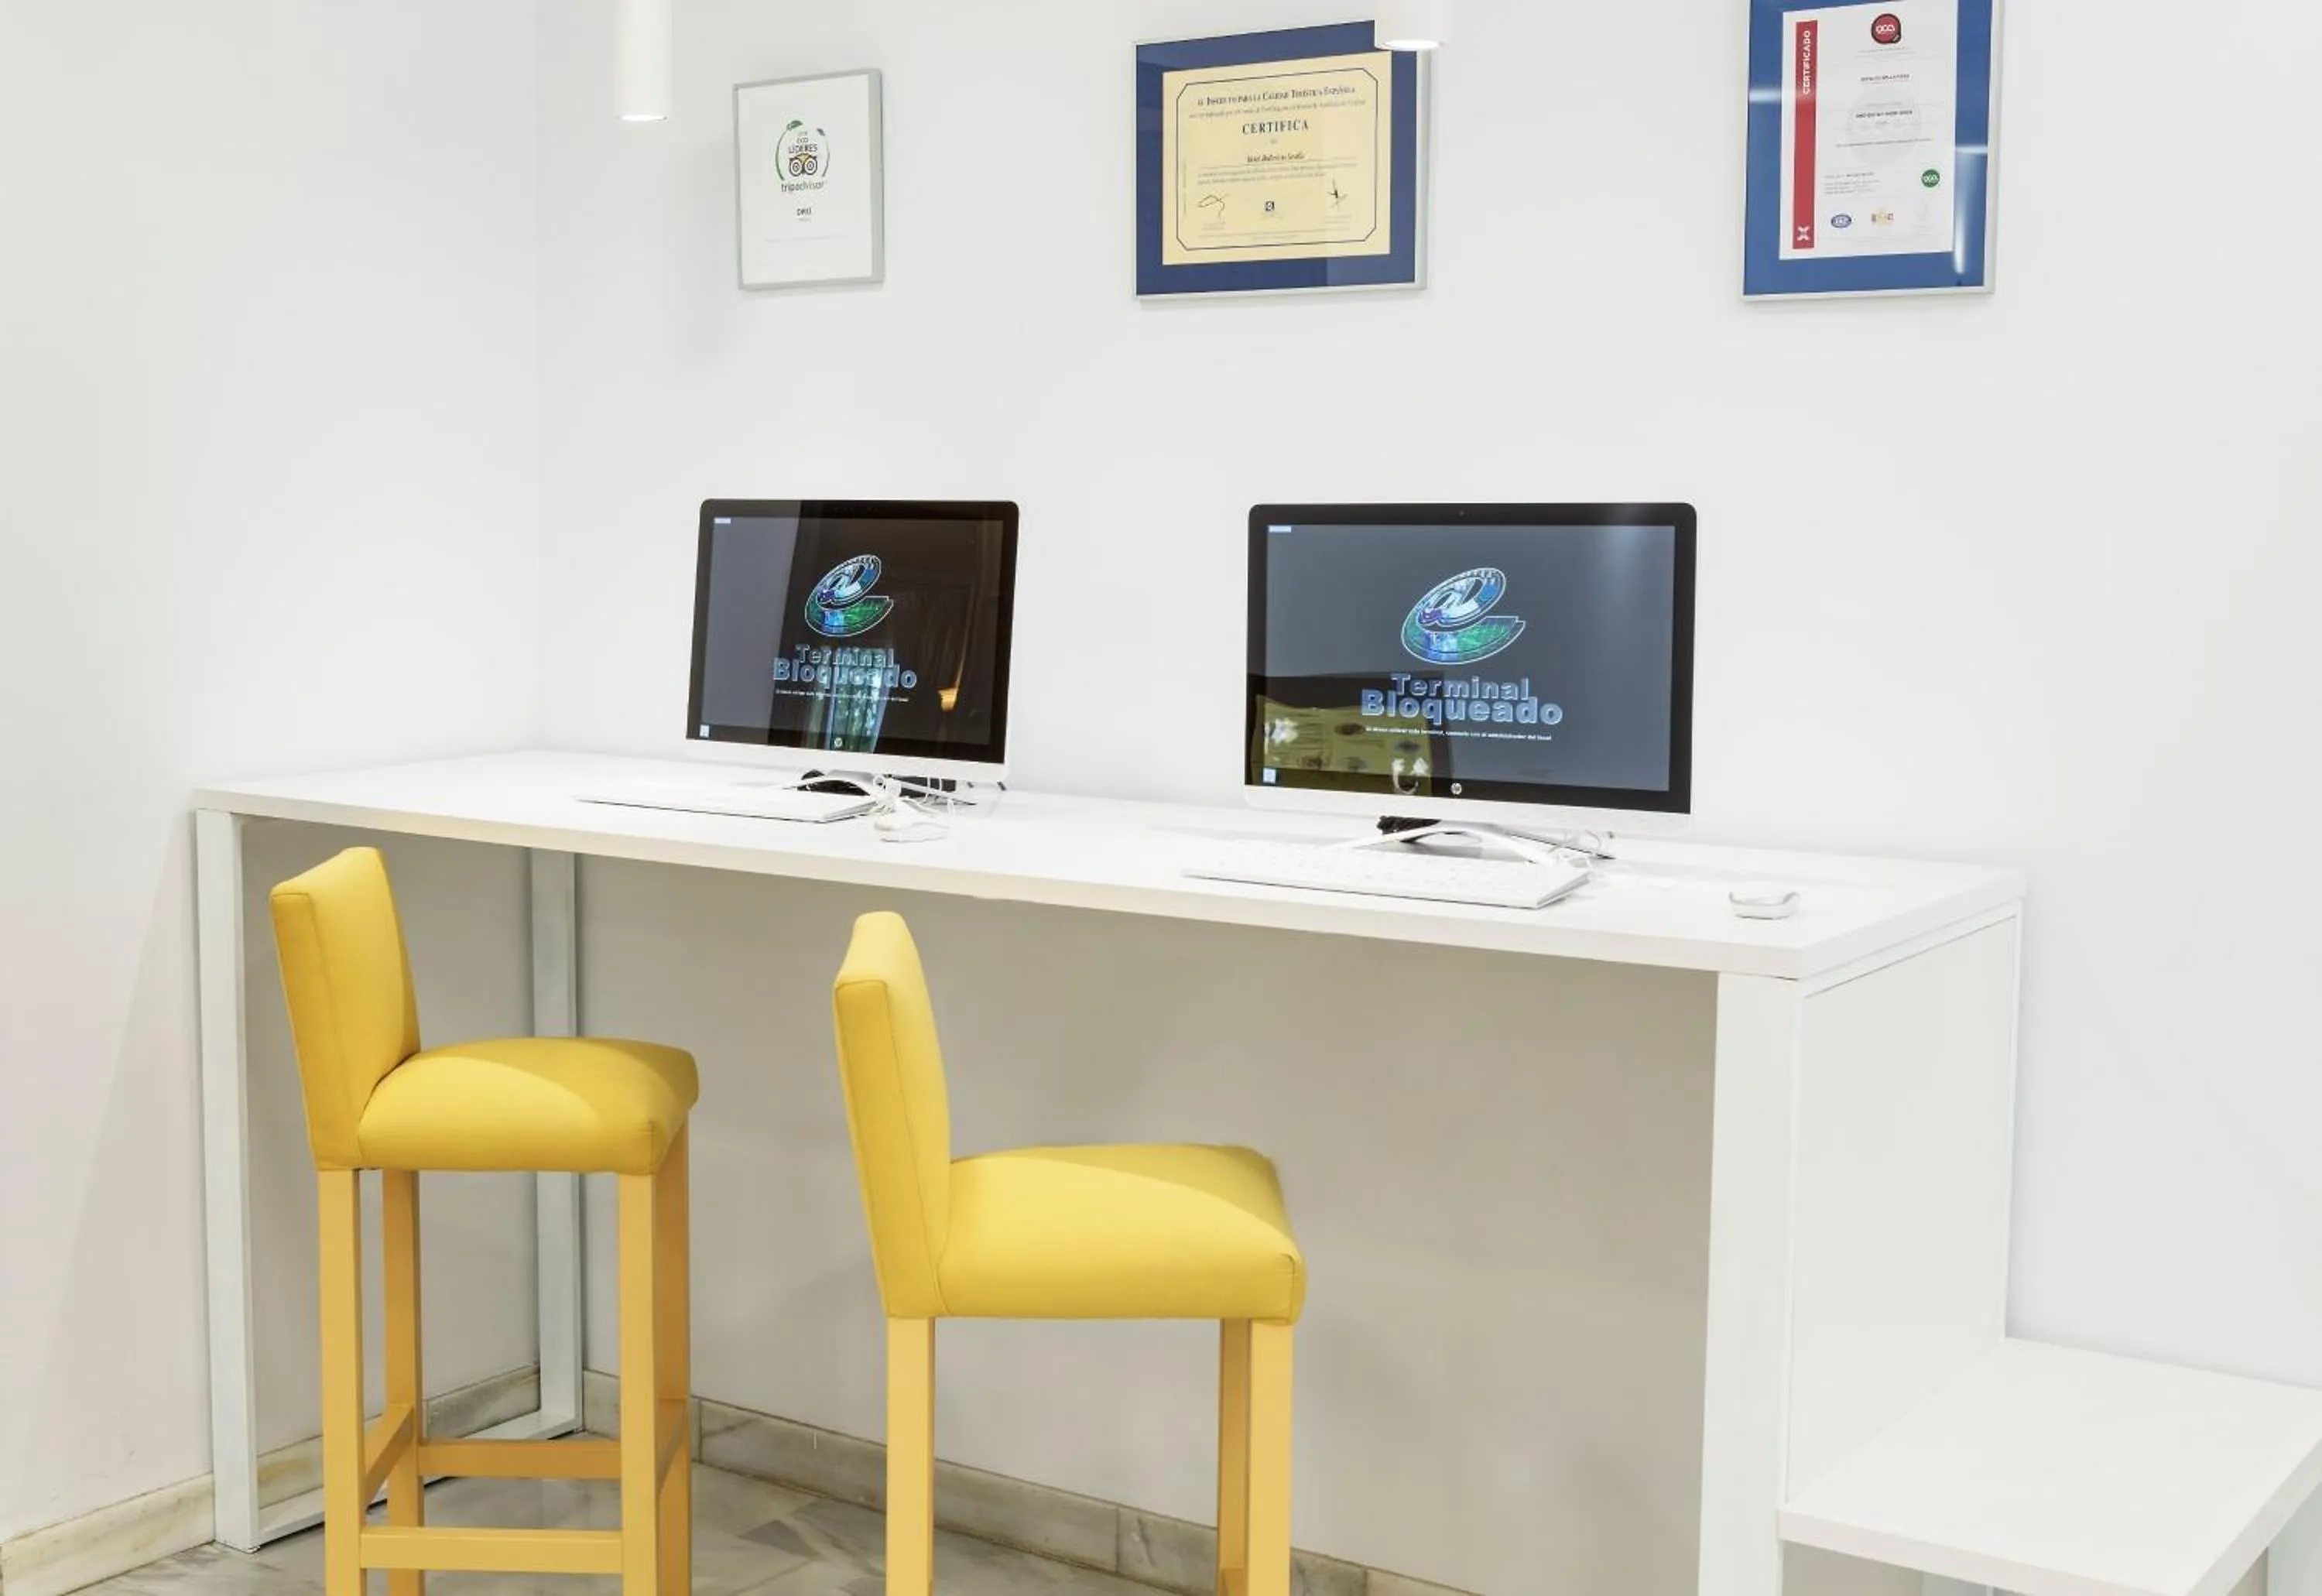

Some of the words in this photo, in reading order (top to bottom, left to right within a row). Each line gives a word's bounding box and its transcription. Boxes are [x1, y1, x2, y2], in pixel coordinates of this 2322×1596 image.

[1802, 30, 1811, 94] CERTIFICADO
[1241, 118, 1309, 135] CERTIFICA
[796, 643, 894, 668] Terminal
[772, 657, 917, 689] Bloqueado
[1391, 672, 1529, 700] Terminal
[1361, 689, 1563, 726] Bloqueado
